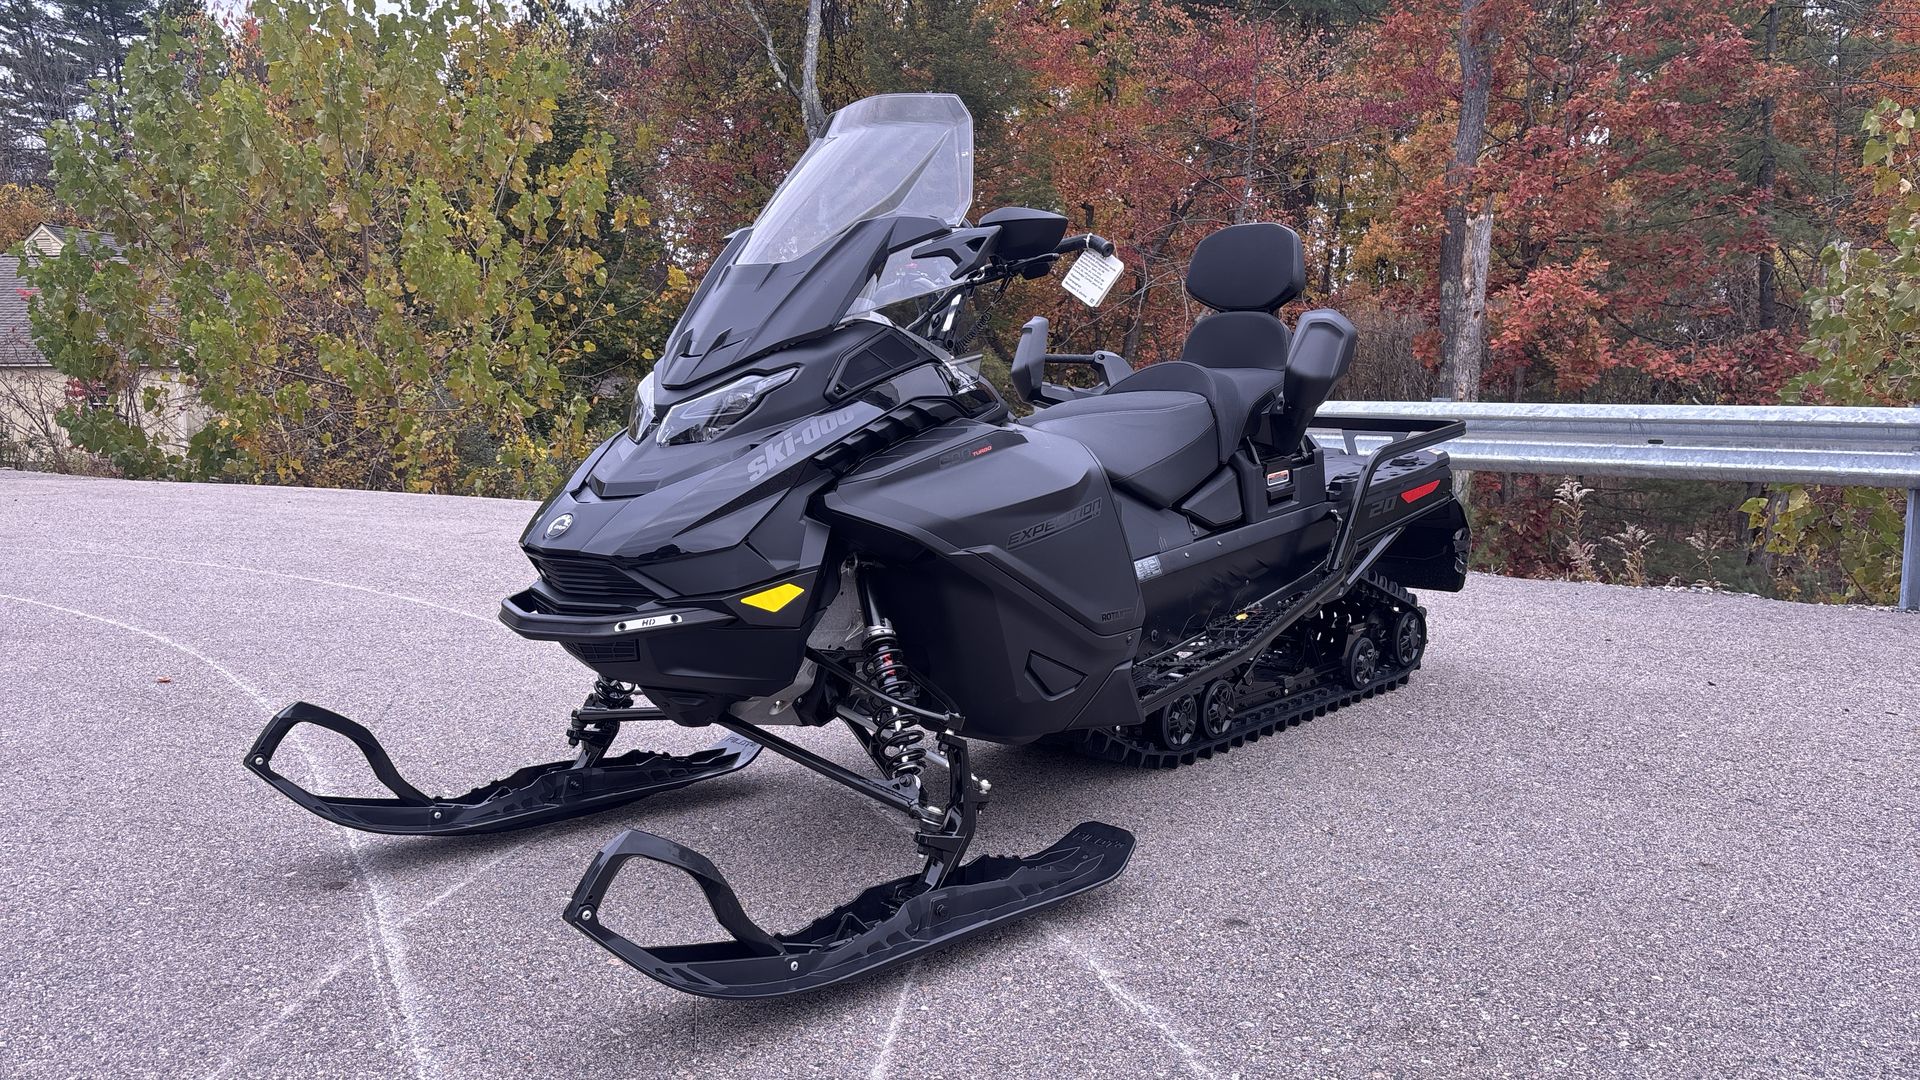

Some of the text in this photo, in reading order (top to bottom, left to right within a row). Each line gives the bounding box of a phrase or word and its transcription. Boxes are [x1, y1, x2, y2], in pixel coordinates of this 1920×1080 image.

[747, 408, 855, 482] ski-doo
[971, 445, 992, 457] TURBO
[1369, 496, 1398, 518] 20
[642, 619, 655, 627] HD
